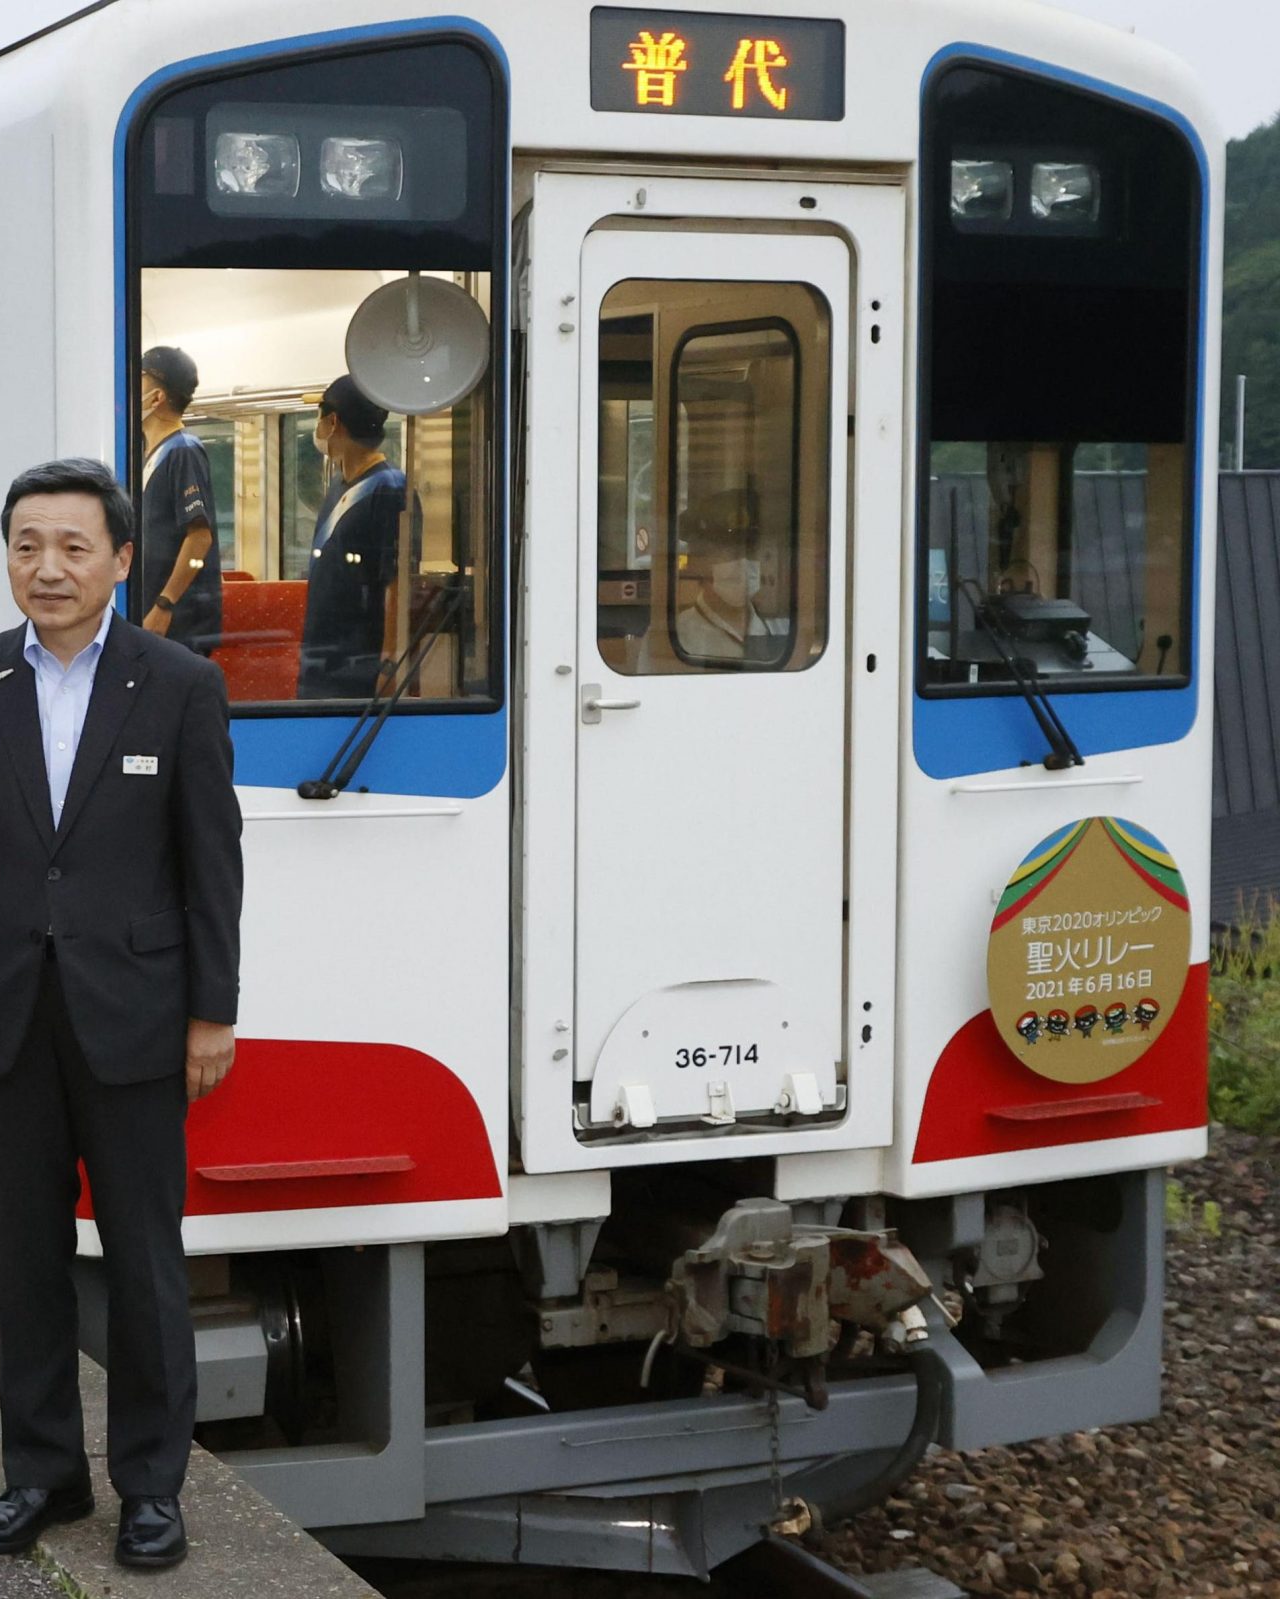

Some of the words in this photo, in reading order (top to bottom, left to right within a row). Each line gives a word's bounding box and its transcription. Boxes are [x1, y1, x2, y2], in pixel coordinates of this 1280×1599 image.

[622, 31, 787, 110] 普代
[1022, 906, 1162, 935] 東京2020オリンピック
[1026, 935, 1155, 975] 聖火リレー
[1026, 969, 1152, 1000] 2021年6月16日
[675, 1043, 759, 1069] 36-714
